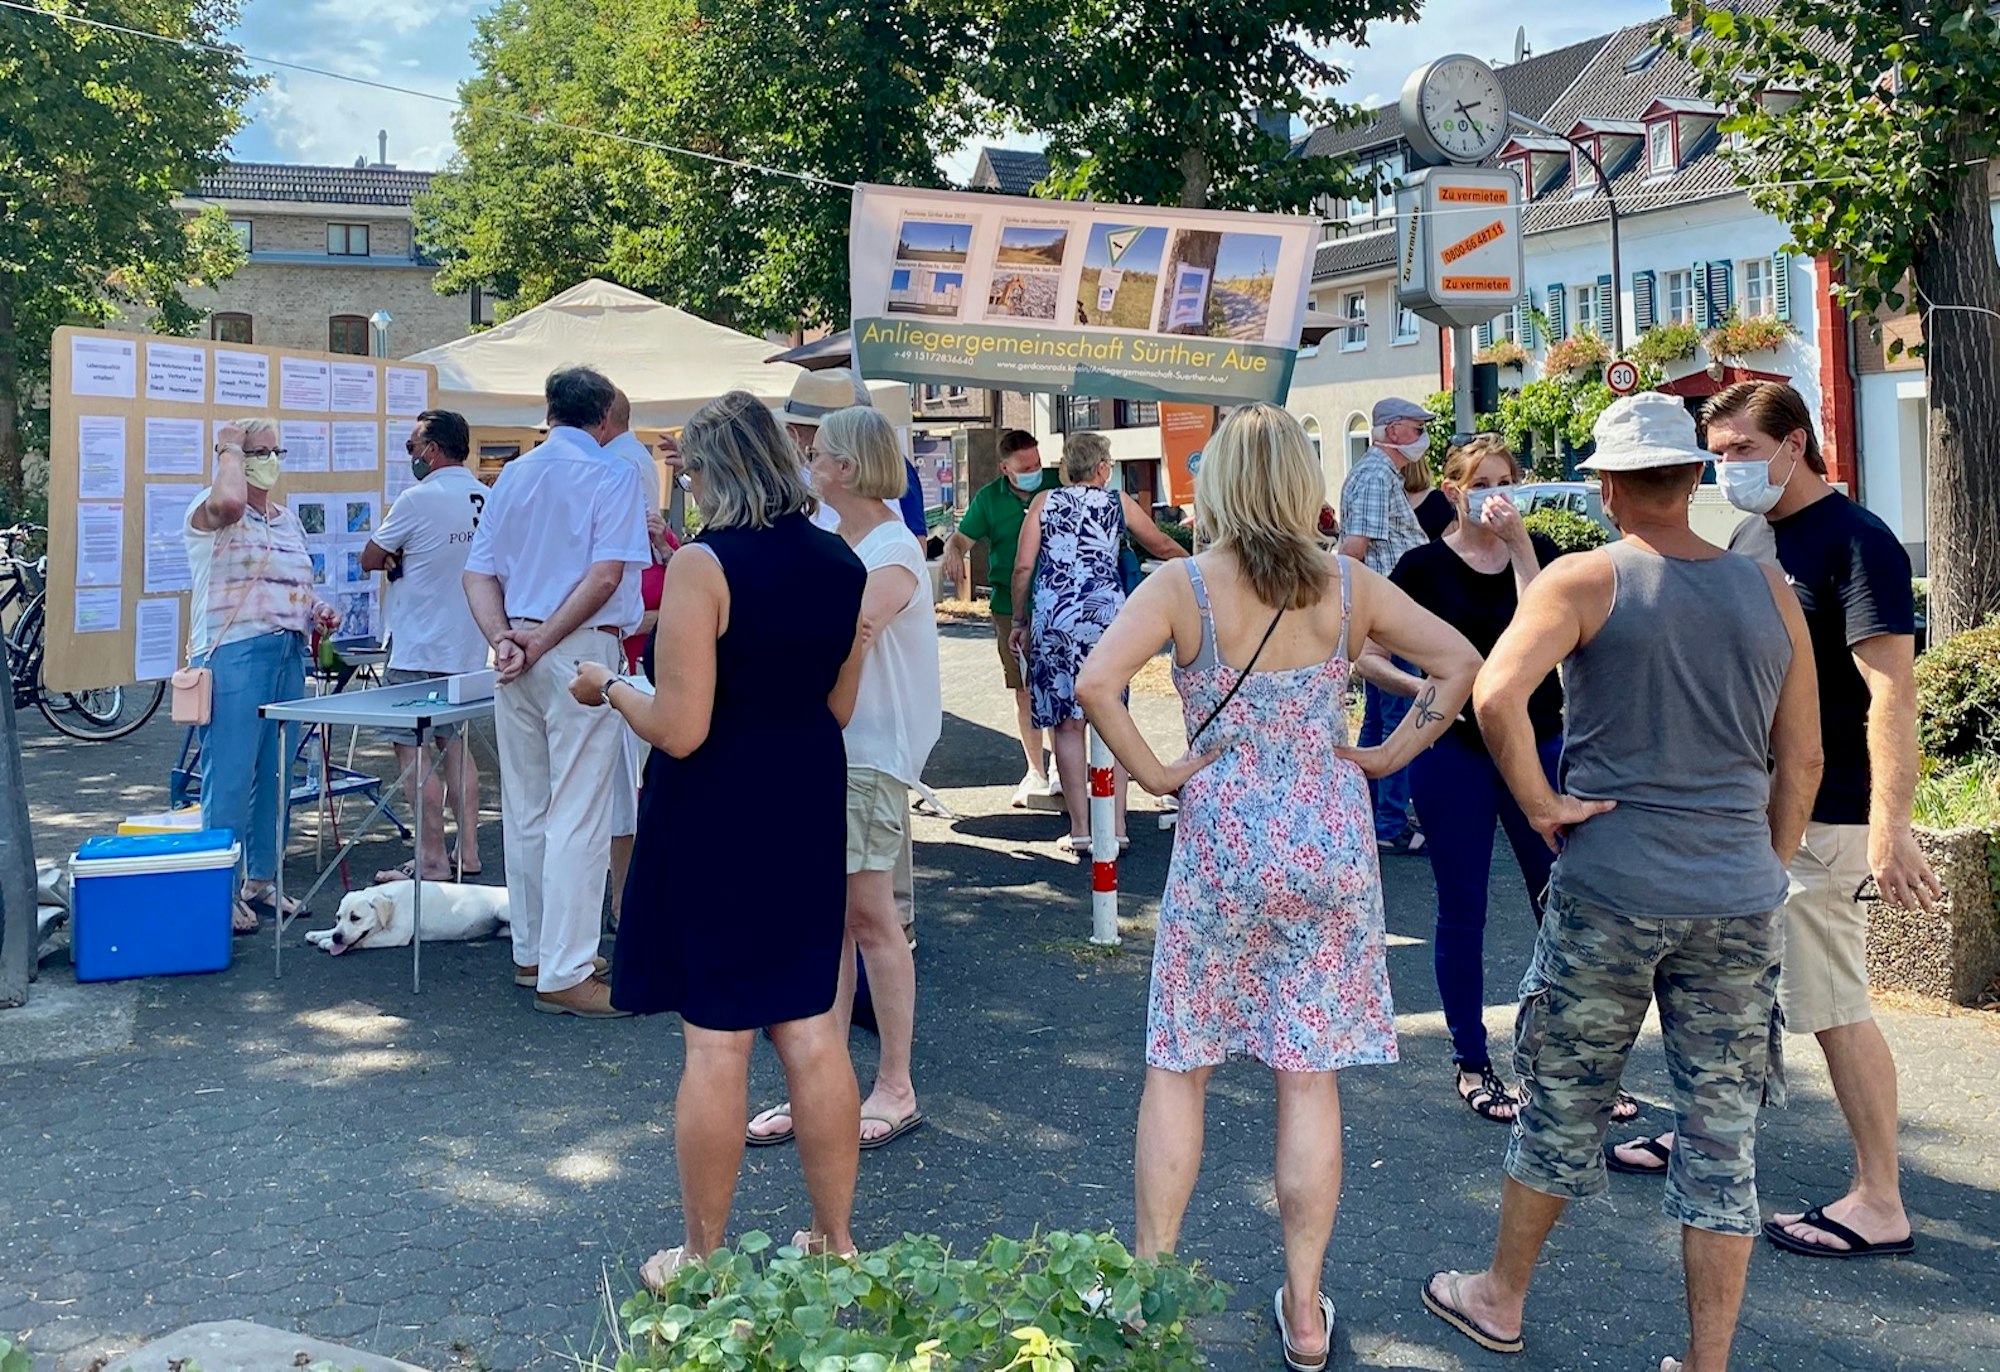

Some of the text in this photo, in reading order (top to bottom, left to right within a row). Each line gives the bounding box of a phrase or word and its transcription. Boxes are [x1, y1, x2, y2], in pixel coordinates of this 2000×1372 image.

[1442, 189, 1505, 202] Zu vermieten
[1492, 223, 1503, 239] 11
[1403, 206, 1419, 282] Zu vermieten
[1445, 279, 1509, 290] Zu vermieten
[862, 321, 1267, 373] Anliegergemeinschaft Sürther Aue
[893, 351, 912, 361] +49
[1613, 370, 1631, 385] 30
